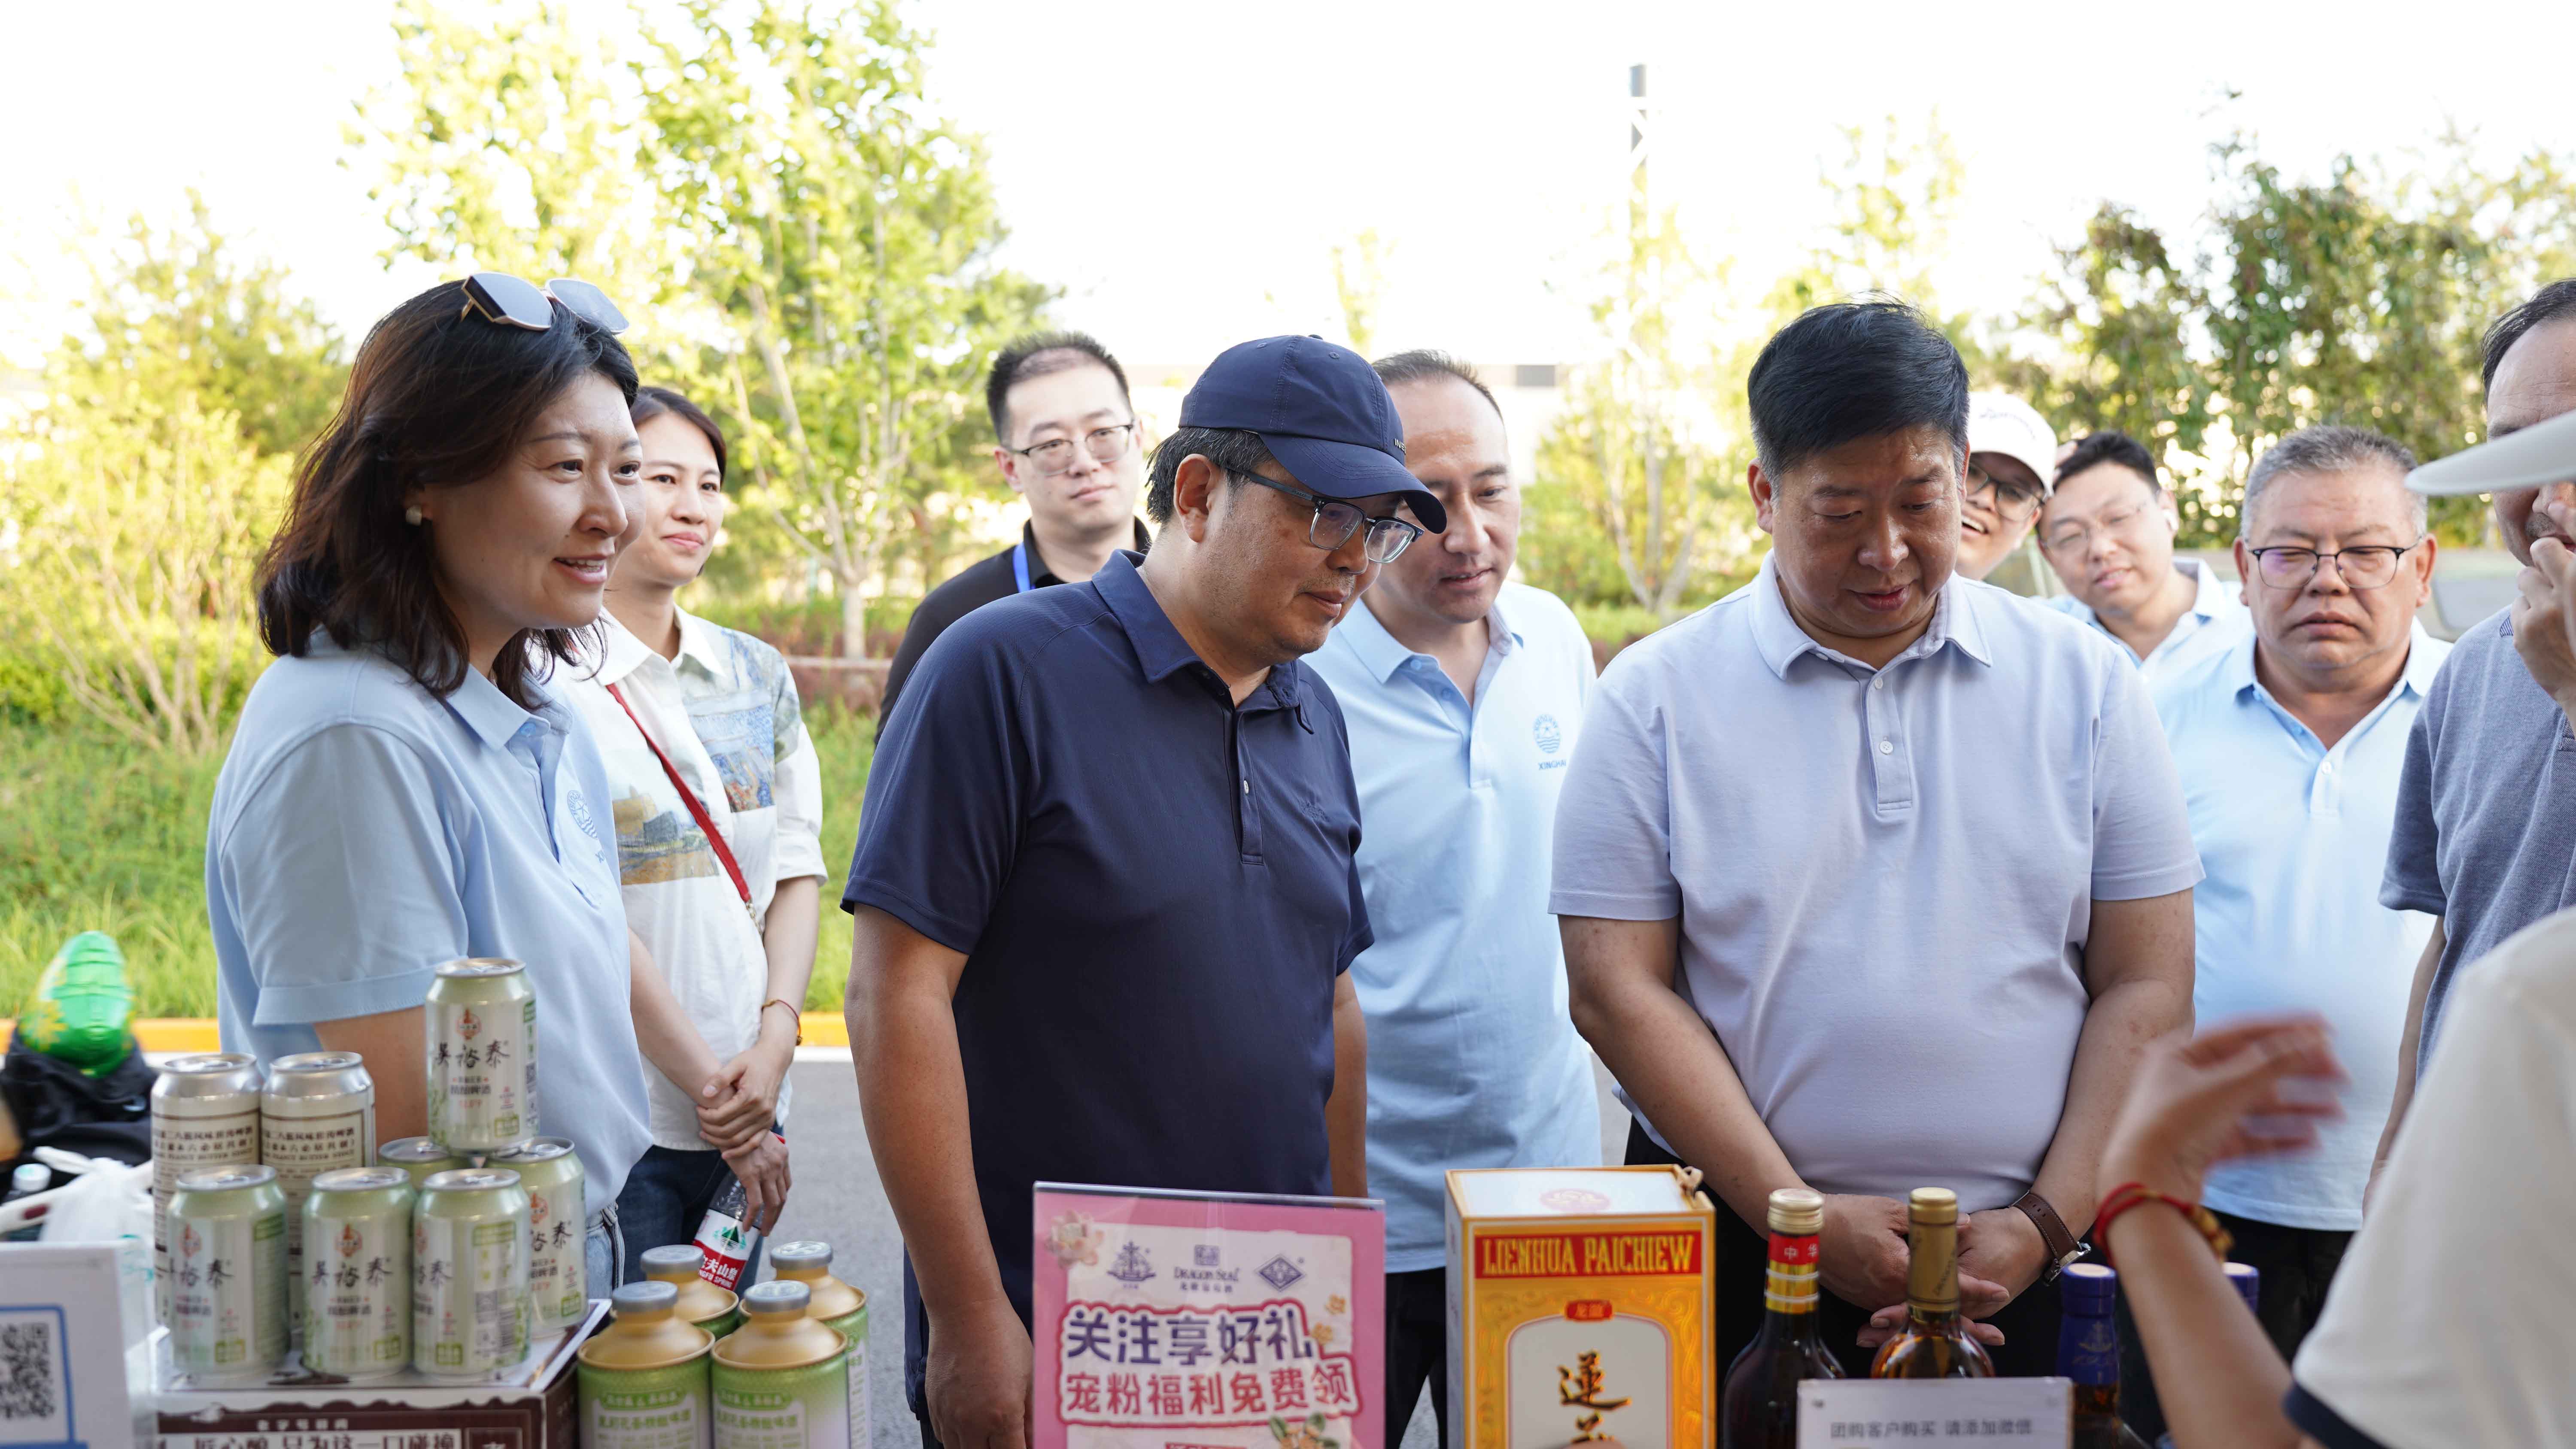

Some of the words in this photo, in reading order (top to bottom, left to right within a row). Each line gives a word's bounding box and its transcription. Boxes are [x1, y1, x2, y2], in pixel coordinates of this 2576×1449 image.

[1482, 1237, 1577, 1276] LIENHUA
[1583, 1234, 1695, 1274] PAICHIEW
[1067, 1308, 1314, 1366] 关注享好礼
[1066, 1361, 1351, 1416] 宠粉福利免费领
[1830, 1421, 1938, 1439] 团购客户购买
